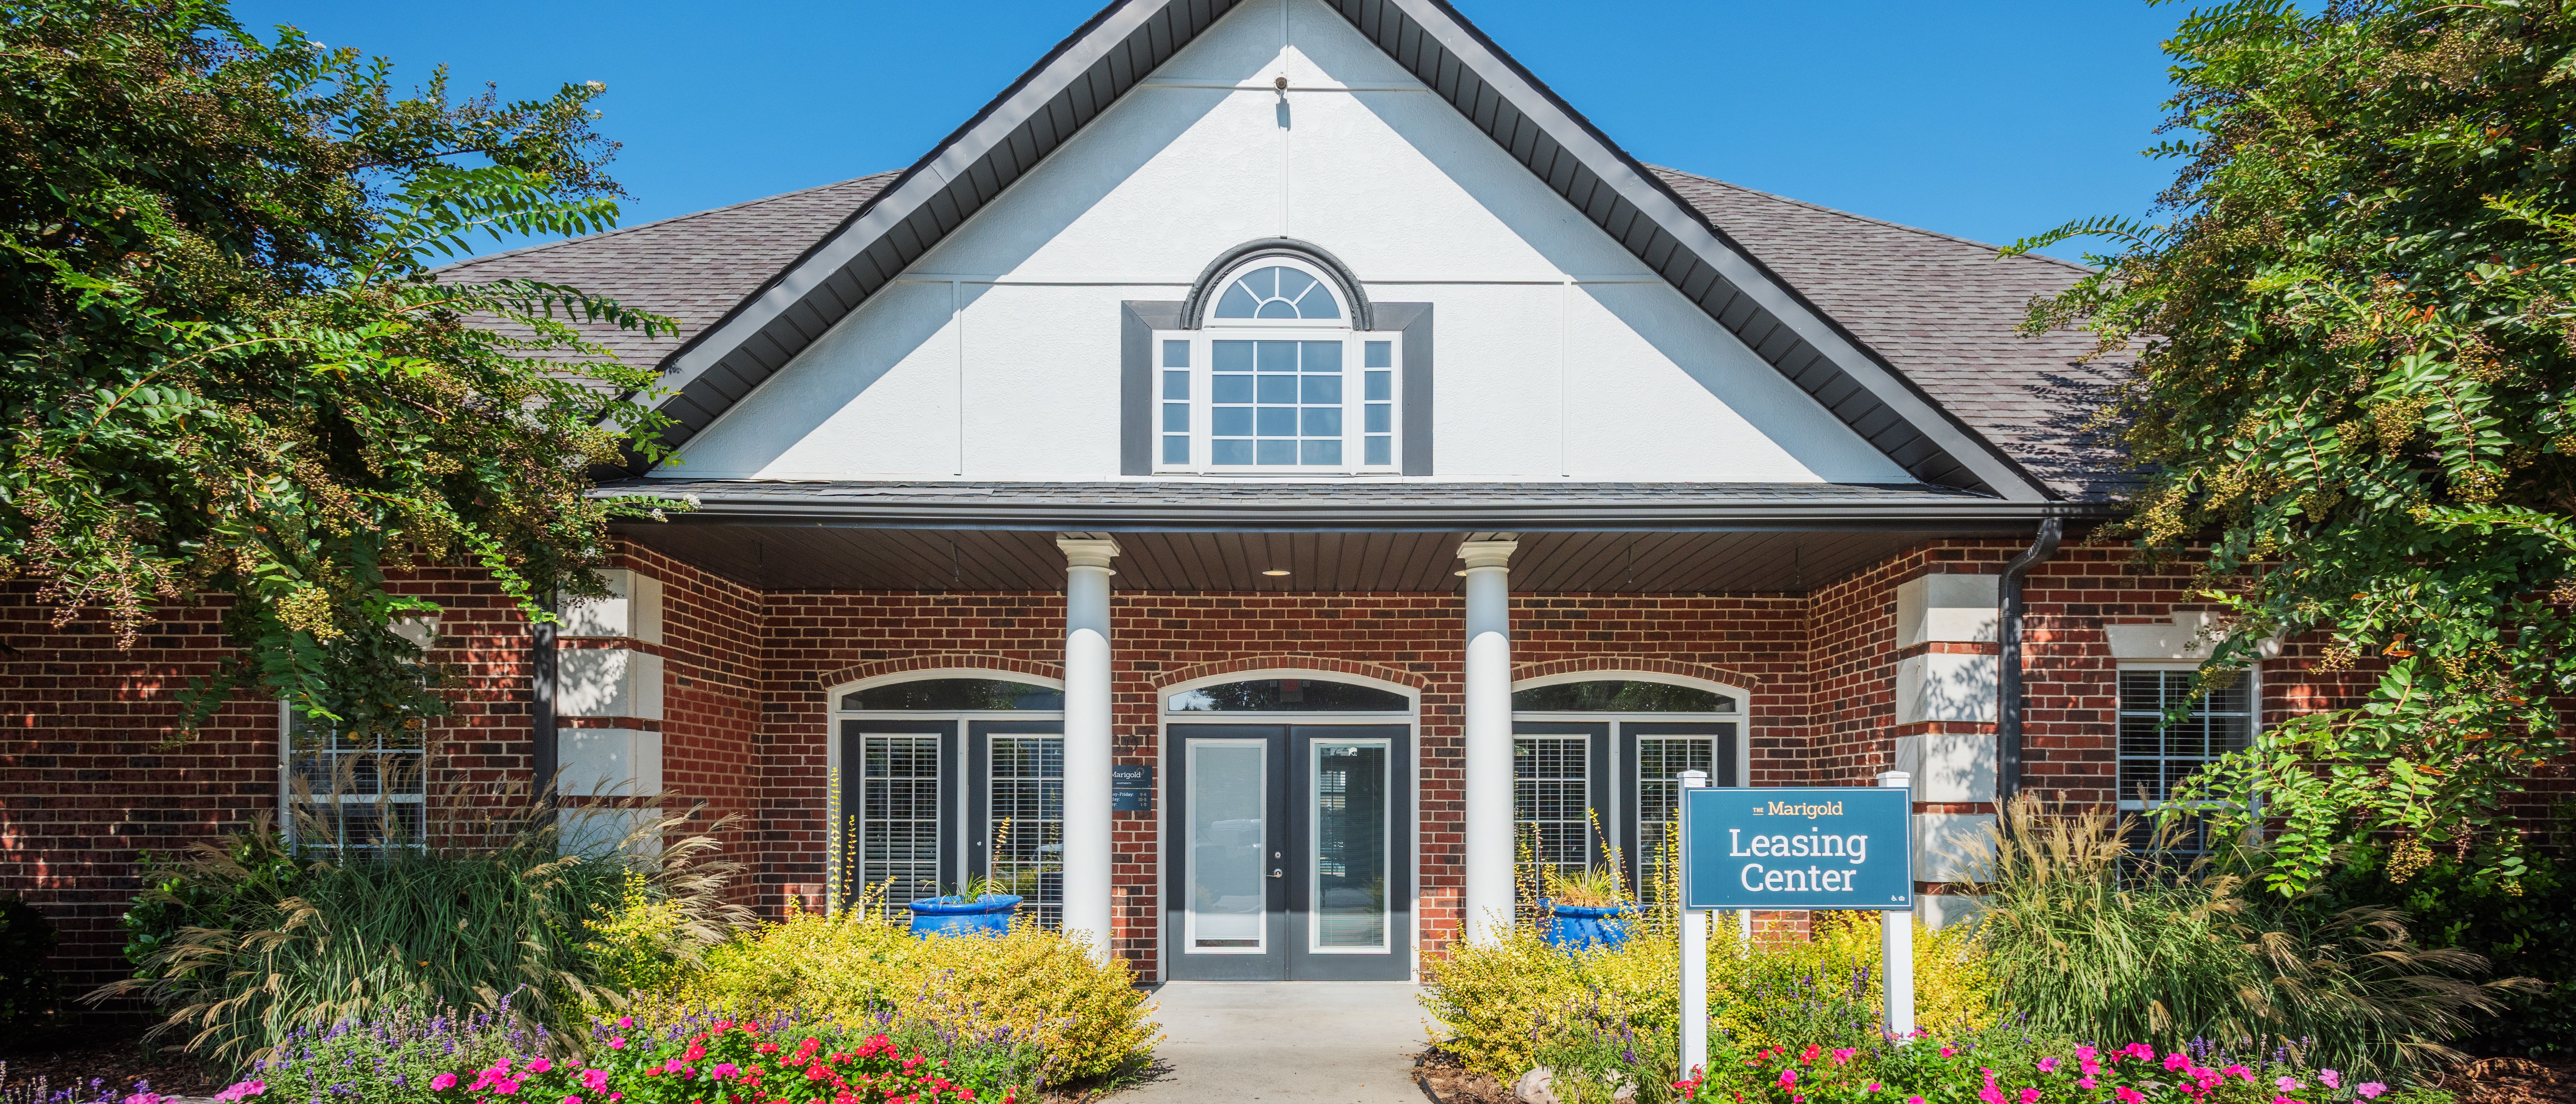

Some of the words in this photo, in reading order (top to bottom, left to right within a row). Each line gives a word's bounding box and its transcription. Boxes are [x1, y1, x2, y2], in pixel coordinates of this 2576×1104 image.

[1767, 801, 1844, 819] Marigold
[1729, 827, 1868, 864] Leasing
[1741, 863, 1857, 892] Center
